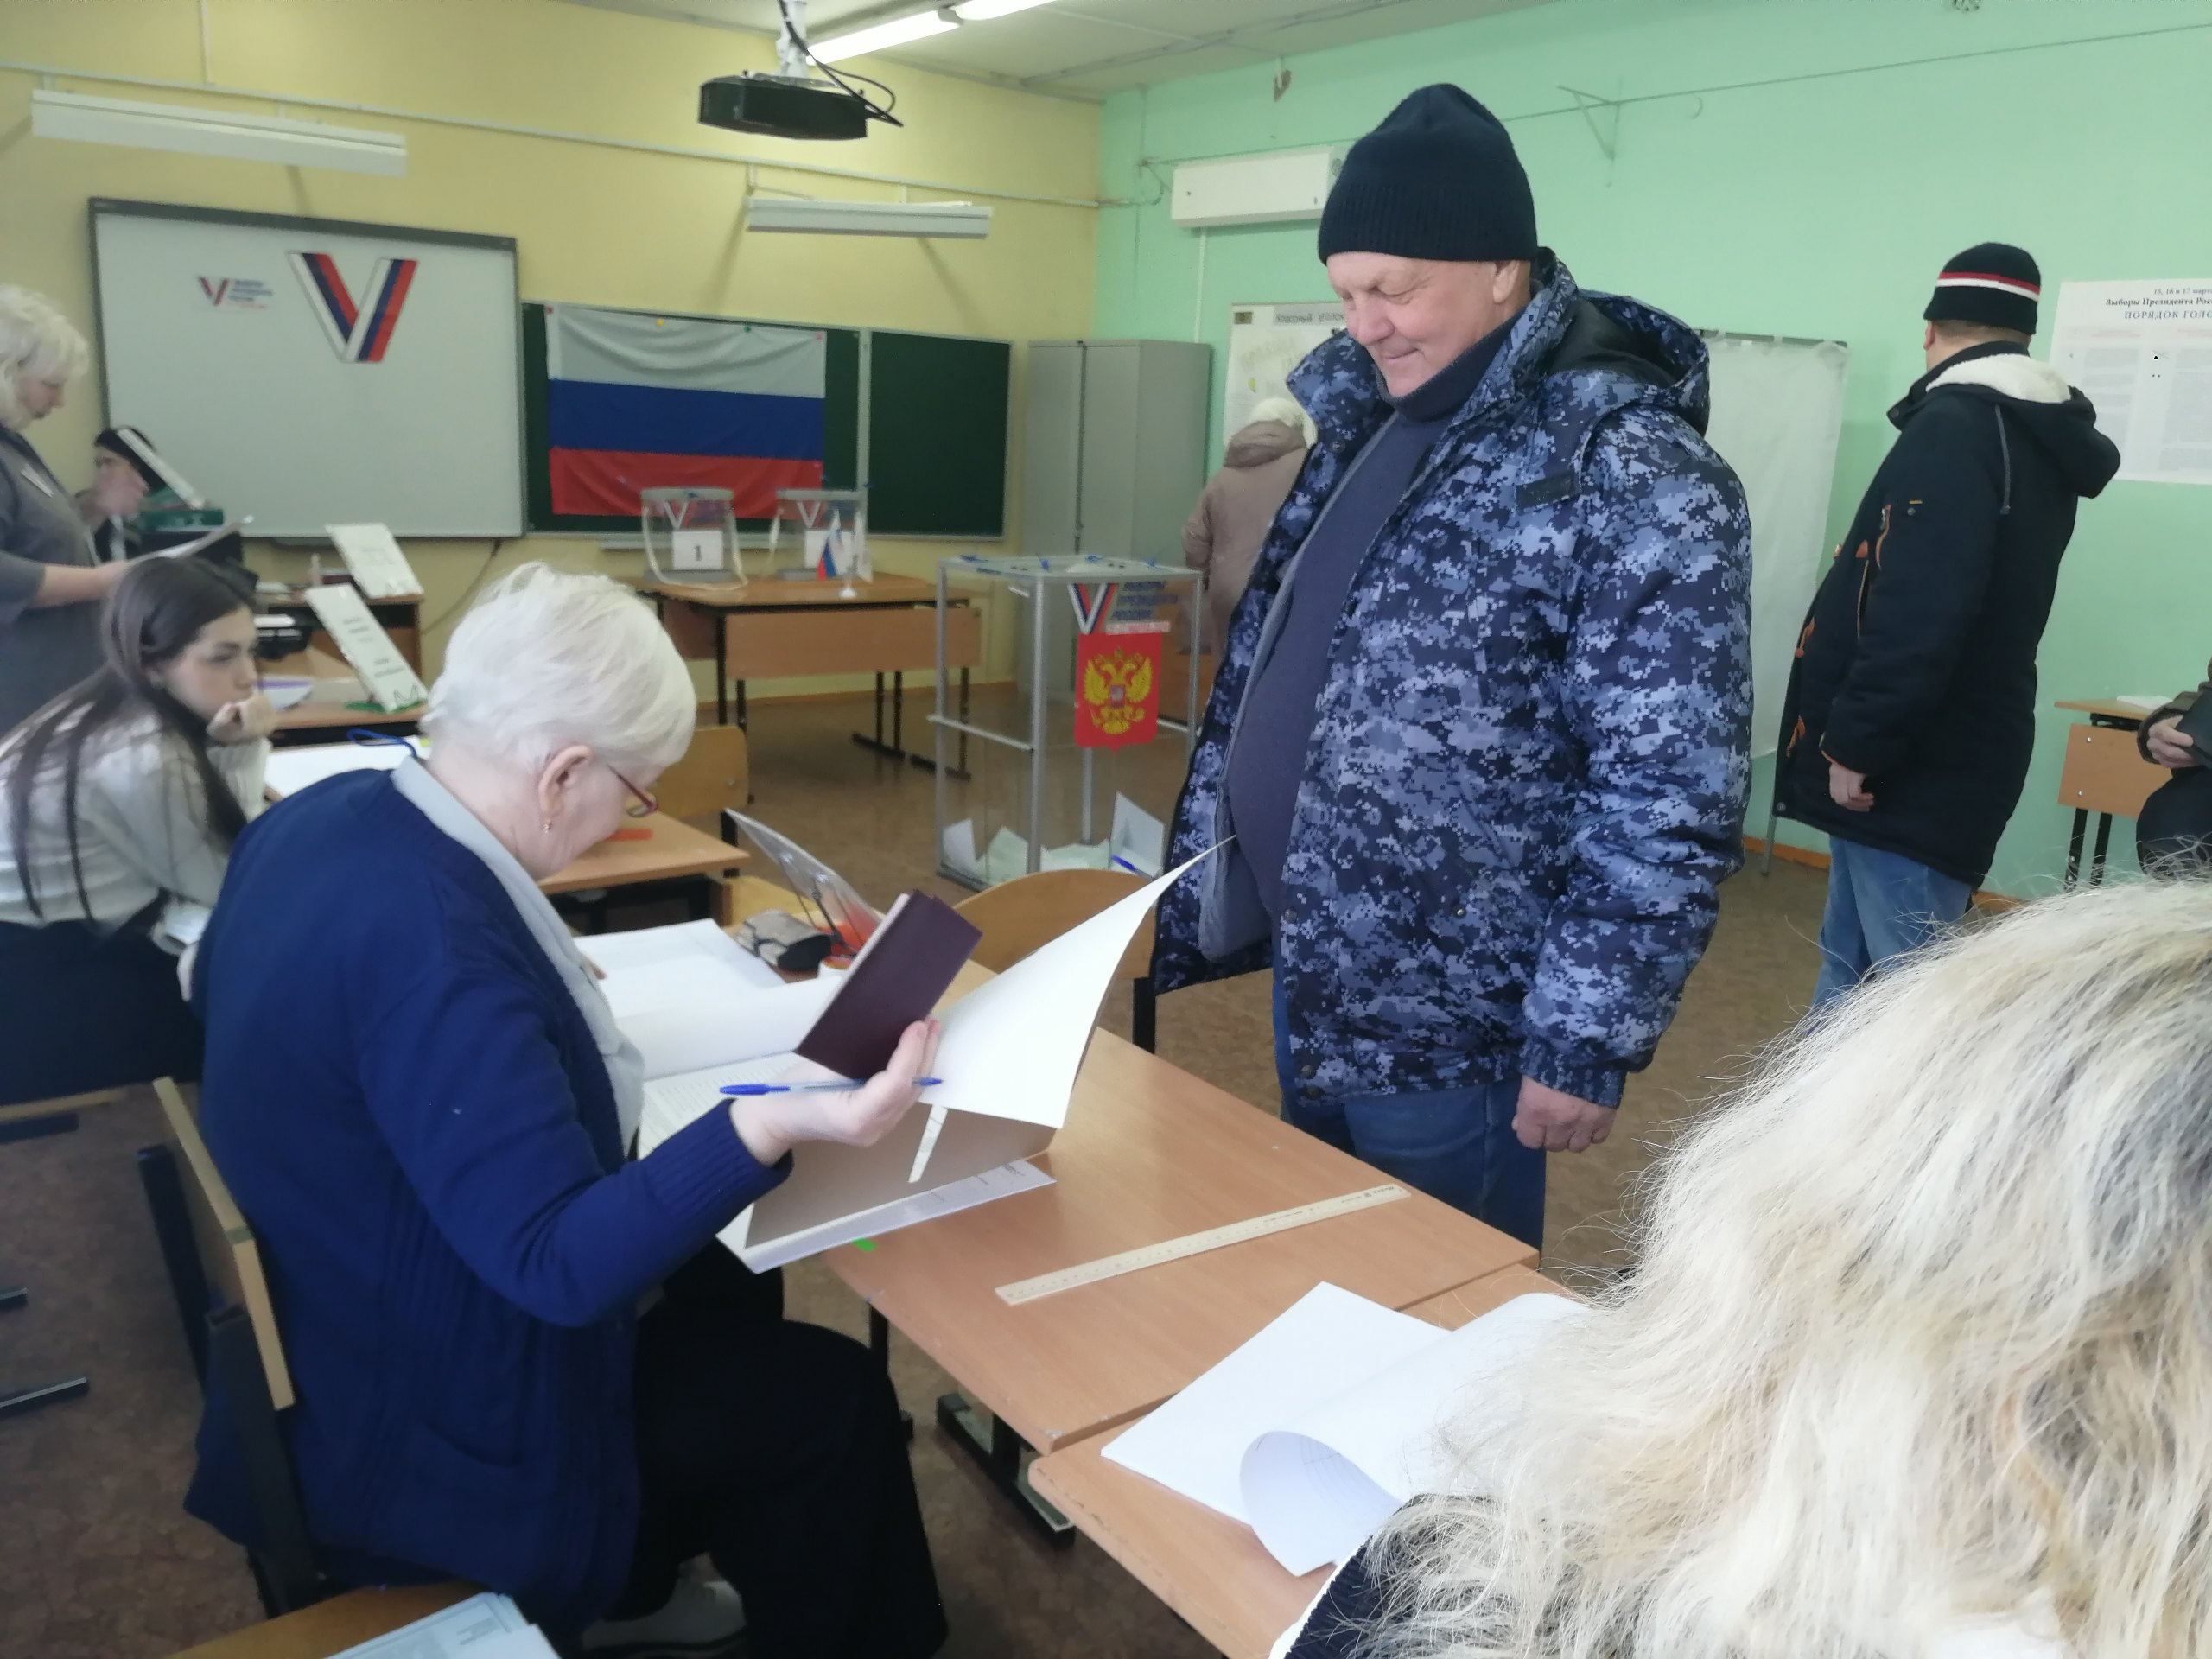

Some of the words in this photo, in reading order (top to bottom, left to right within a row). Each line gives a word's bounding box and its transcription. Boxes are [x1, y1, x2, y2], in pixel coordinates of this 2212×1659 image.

[2106, 298, 2140, 308] Выборы
[2142, 297, 2194, 307] Президента
[2196, 296, 2212, 305] Рос
[2124, 310, 2179, 320] ПОРЯДОК
[694, 544, 702, 562] 1
